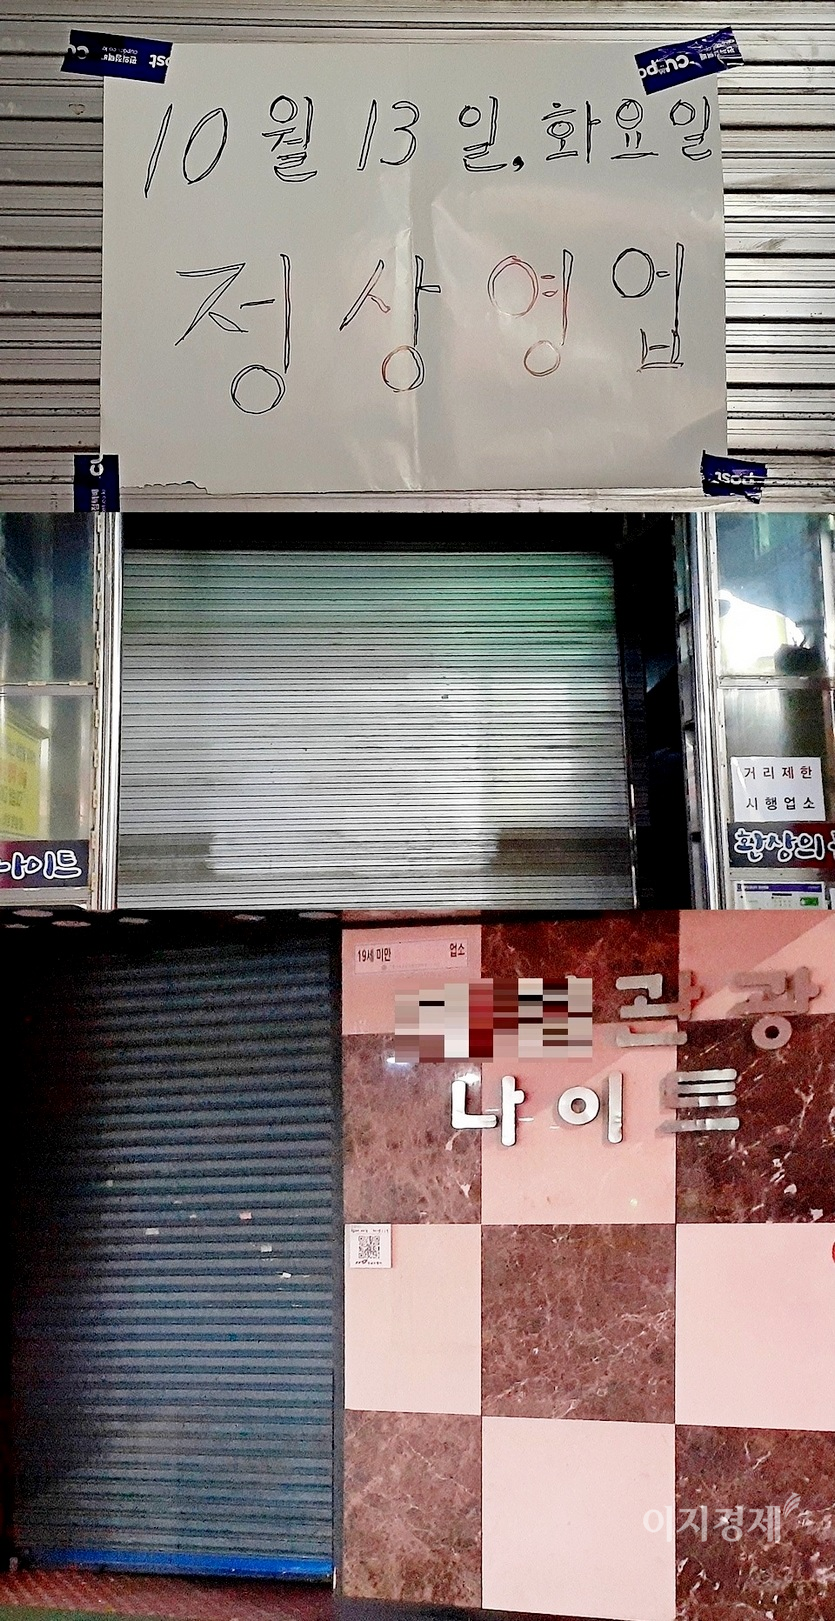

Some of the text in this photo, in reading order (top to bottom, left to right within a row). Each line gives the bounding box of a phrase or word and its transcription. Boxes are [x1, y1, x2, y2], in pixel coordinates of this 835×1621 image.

[540, 95, 713, 162] 화요일
[174, 242, 686, 415] 정상영업
[744, 765, 812, 780] 거리제한
[746, 797, 816, 810] 시행업소
[734, 828, 825, 862] 환상의
[449, 943, 466, 958] 업소
[615, 965, 822, 1050] 관광
[451, 1068, 740, 1147] 나이트
